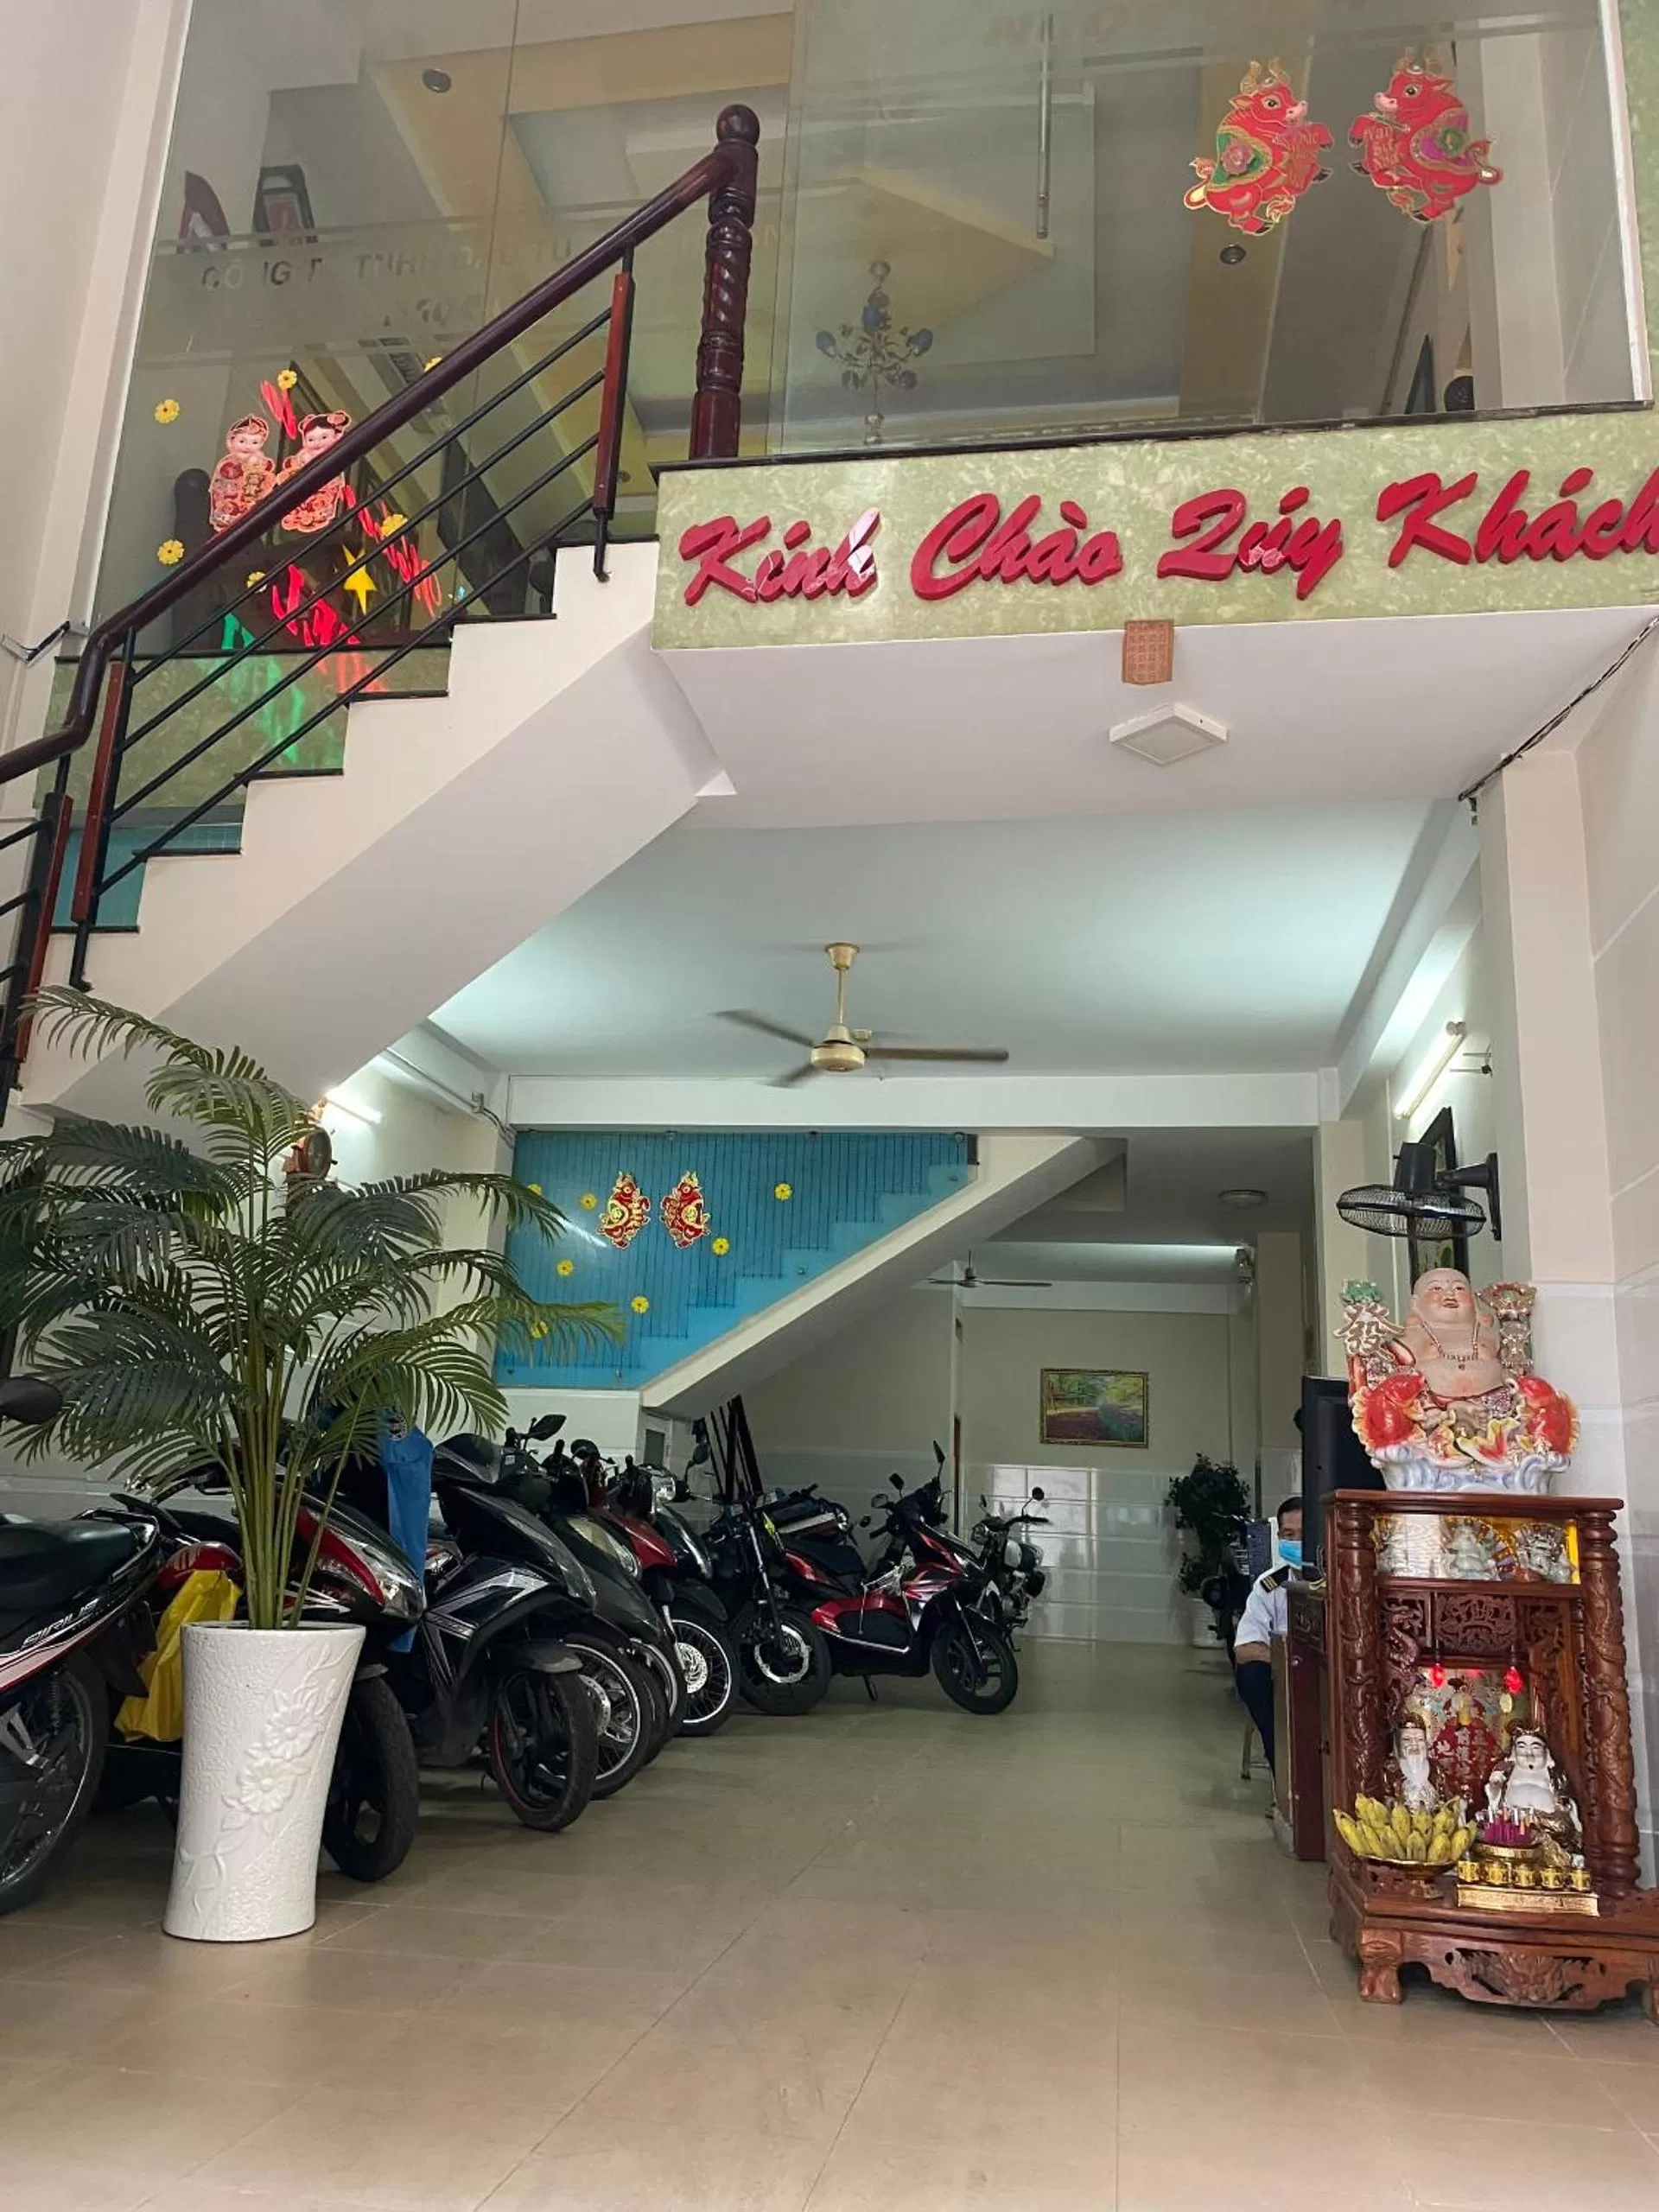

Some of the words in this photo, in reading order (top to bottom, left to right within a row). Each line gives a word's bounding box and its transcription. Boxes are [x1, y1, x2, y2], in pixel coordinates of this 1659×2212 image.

[678, 506, 880, 607] Kính
[910, 492, 1123, 602] Chào
[1376, 467, 1659, 568] Khách
